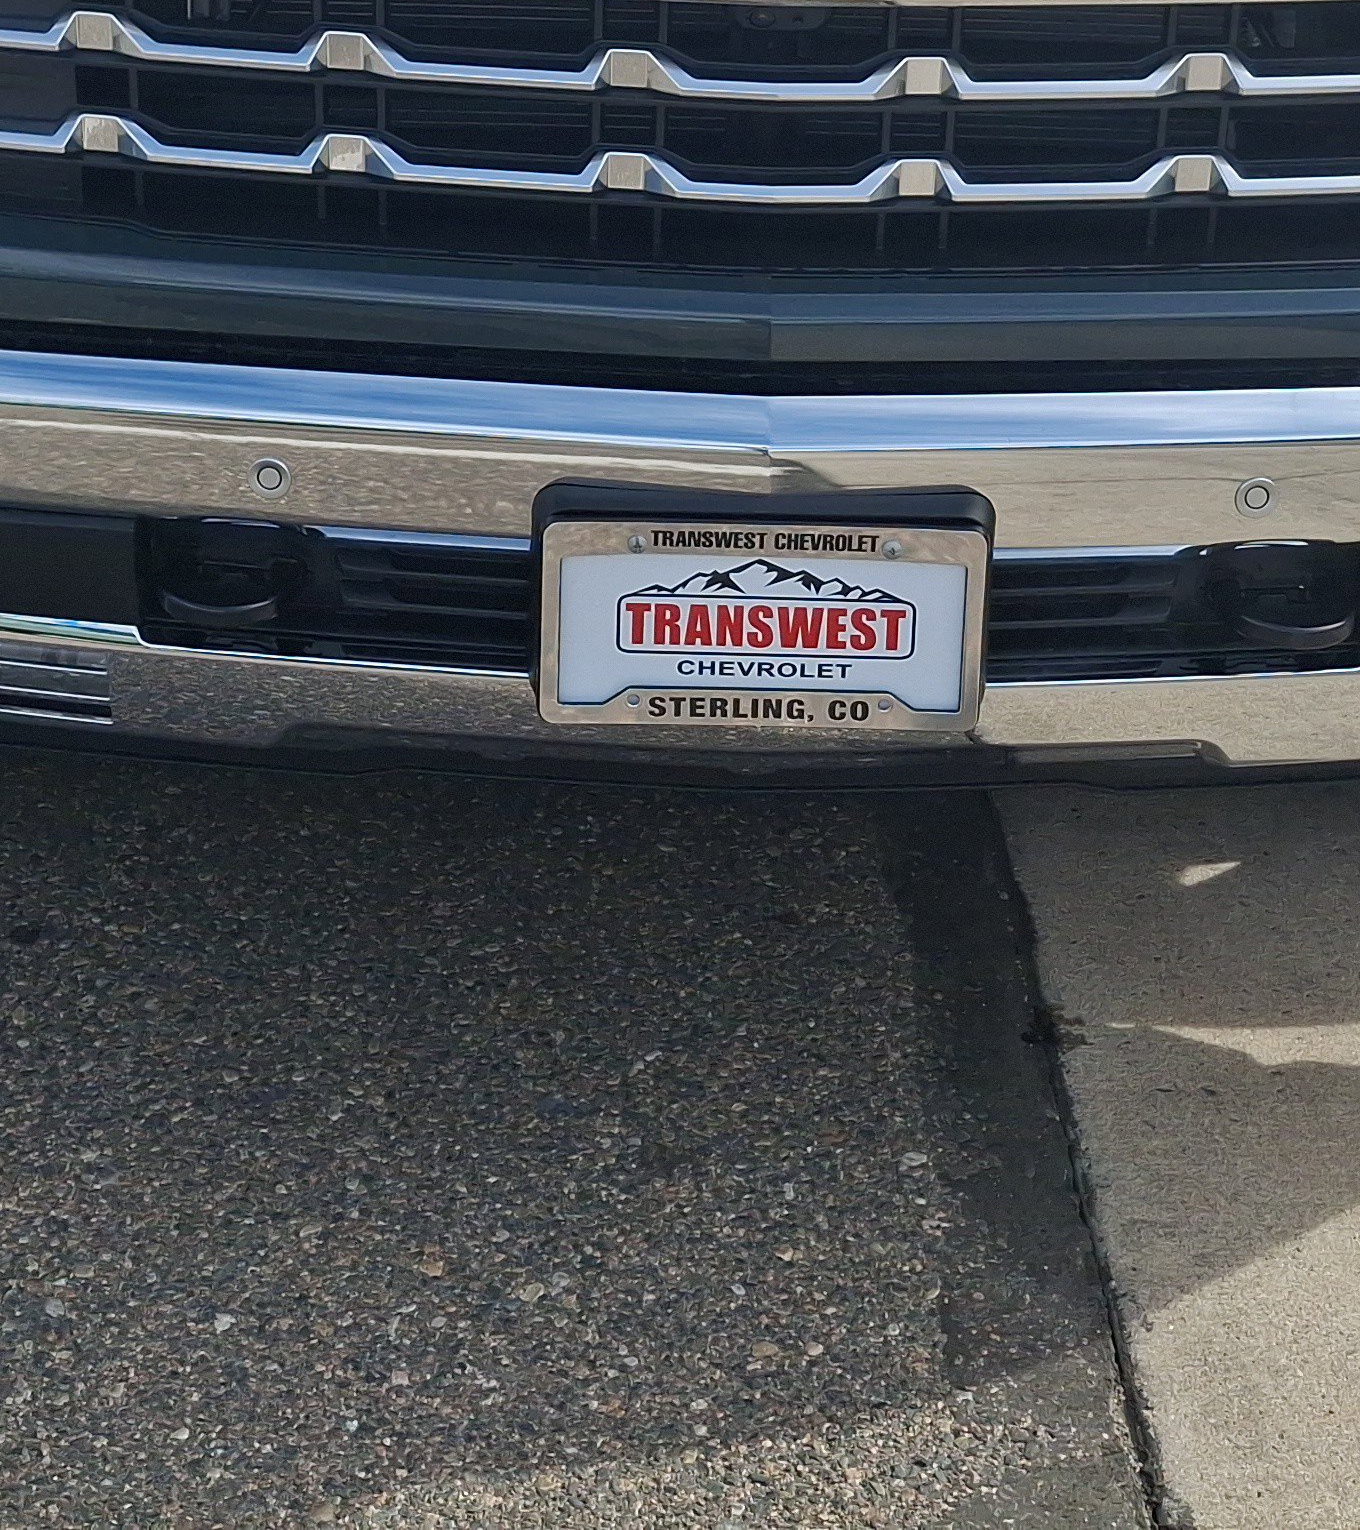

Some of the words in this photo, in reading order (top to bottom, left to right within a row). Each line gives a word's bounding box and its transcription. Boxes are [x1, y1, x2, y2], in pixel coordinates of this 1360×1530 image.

[651, 530, 768, 550] TRANSWEST
[774, 532, 880, 552] CHEVROLET
[625, 602, 907, 651] TRANSWEST
[676, 659, 853, 679] CHEVROLET
[648, 696, 814, 722] STERLING,
[827, 699, 870, 721] CO
